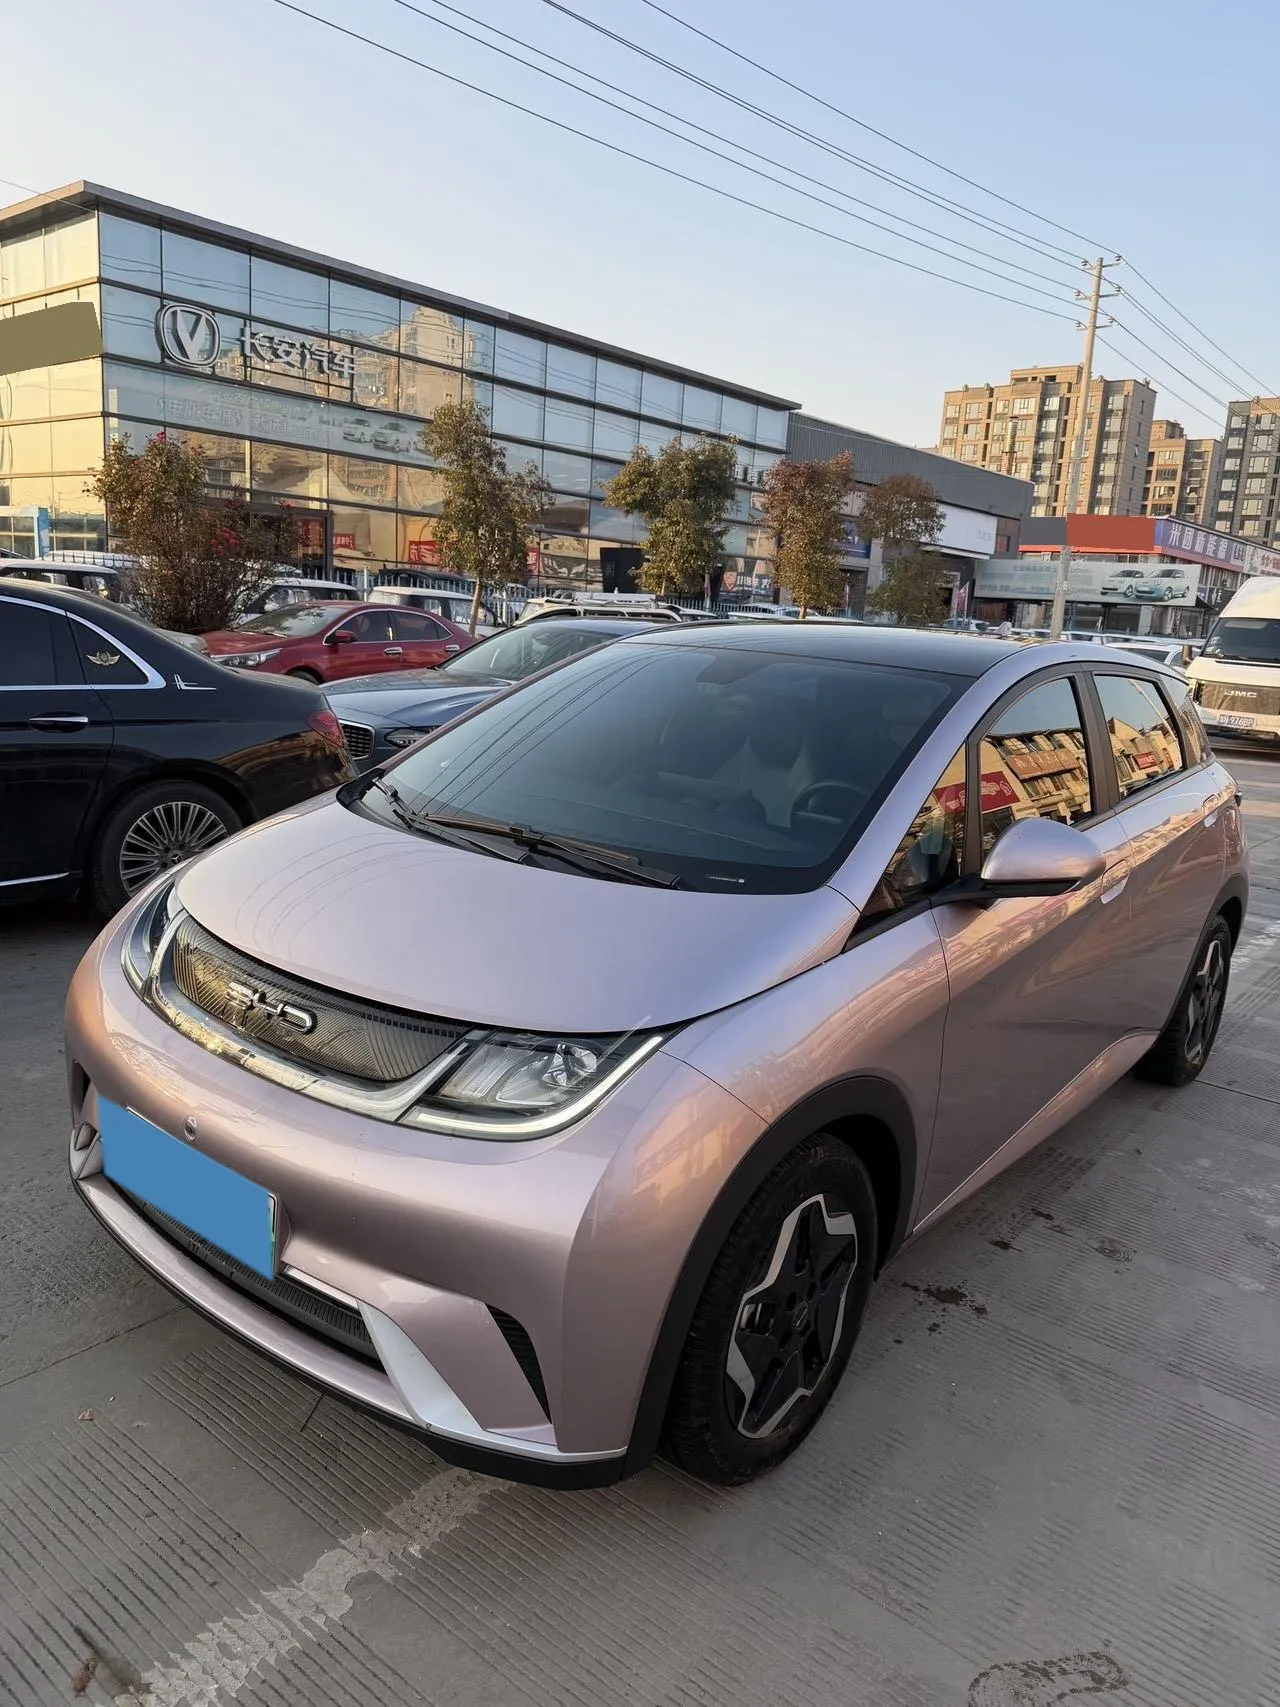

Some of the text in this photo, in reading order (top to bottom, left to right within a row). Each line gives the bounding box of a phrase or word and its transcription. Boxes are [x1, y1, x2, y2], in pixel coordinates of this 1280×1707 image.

[239, 324, 357, 378] 长安汽车
[1224, 690, 1258, 698] JMC
[226, 981, 318, 1035] BYD
